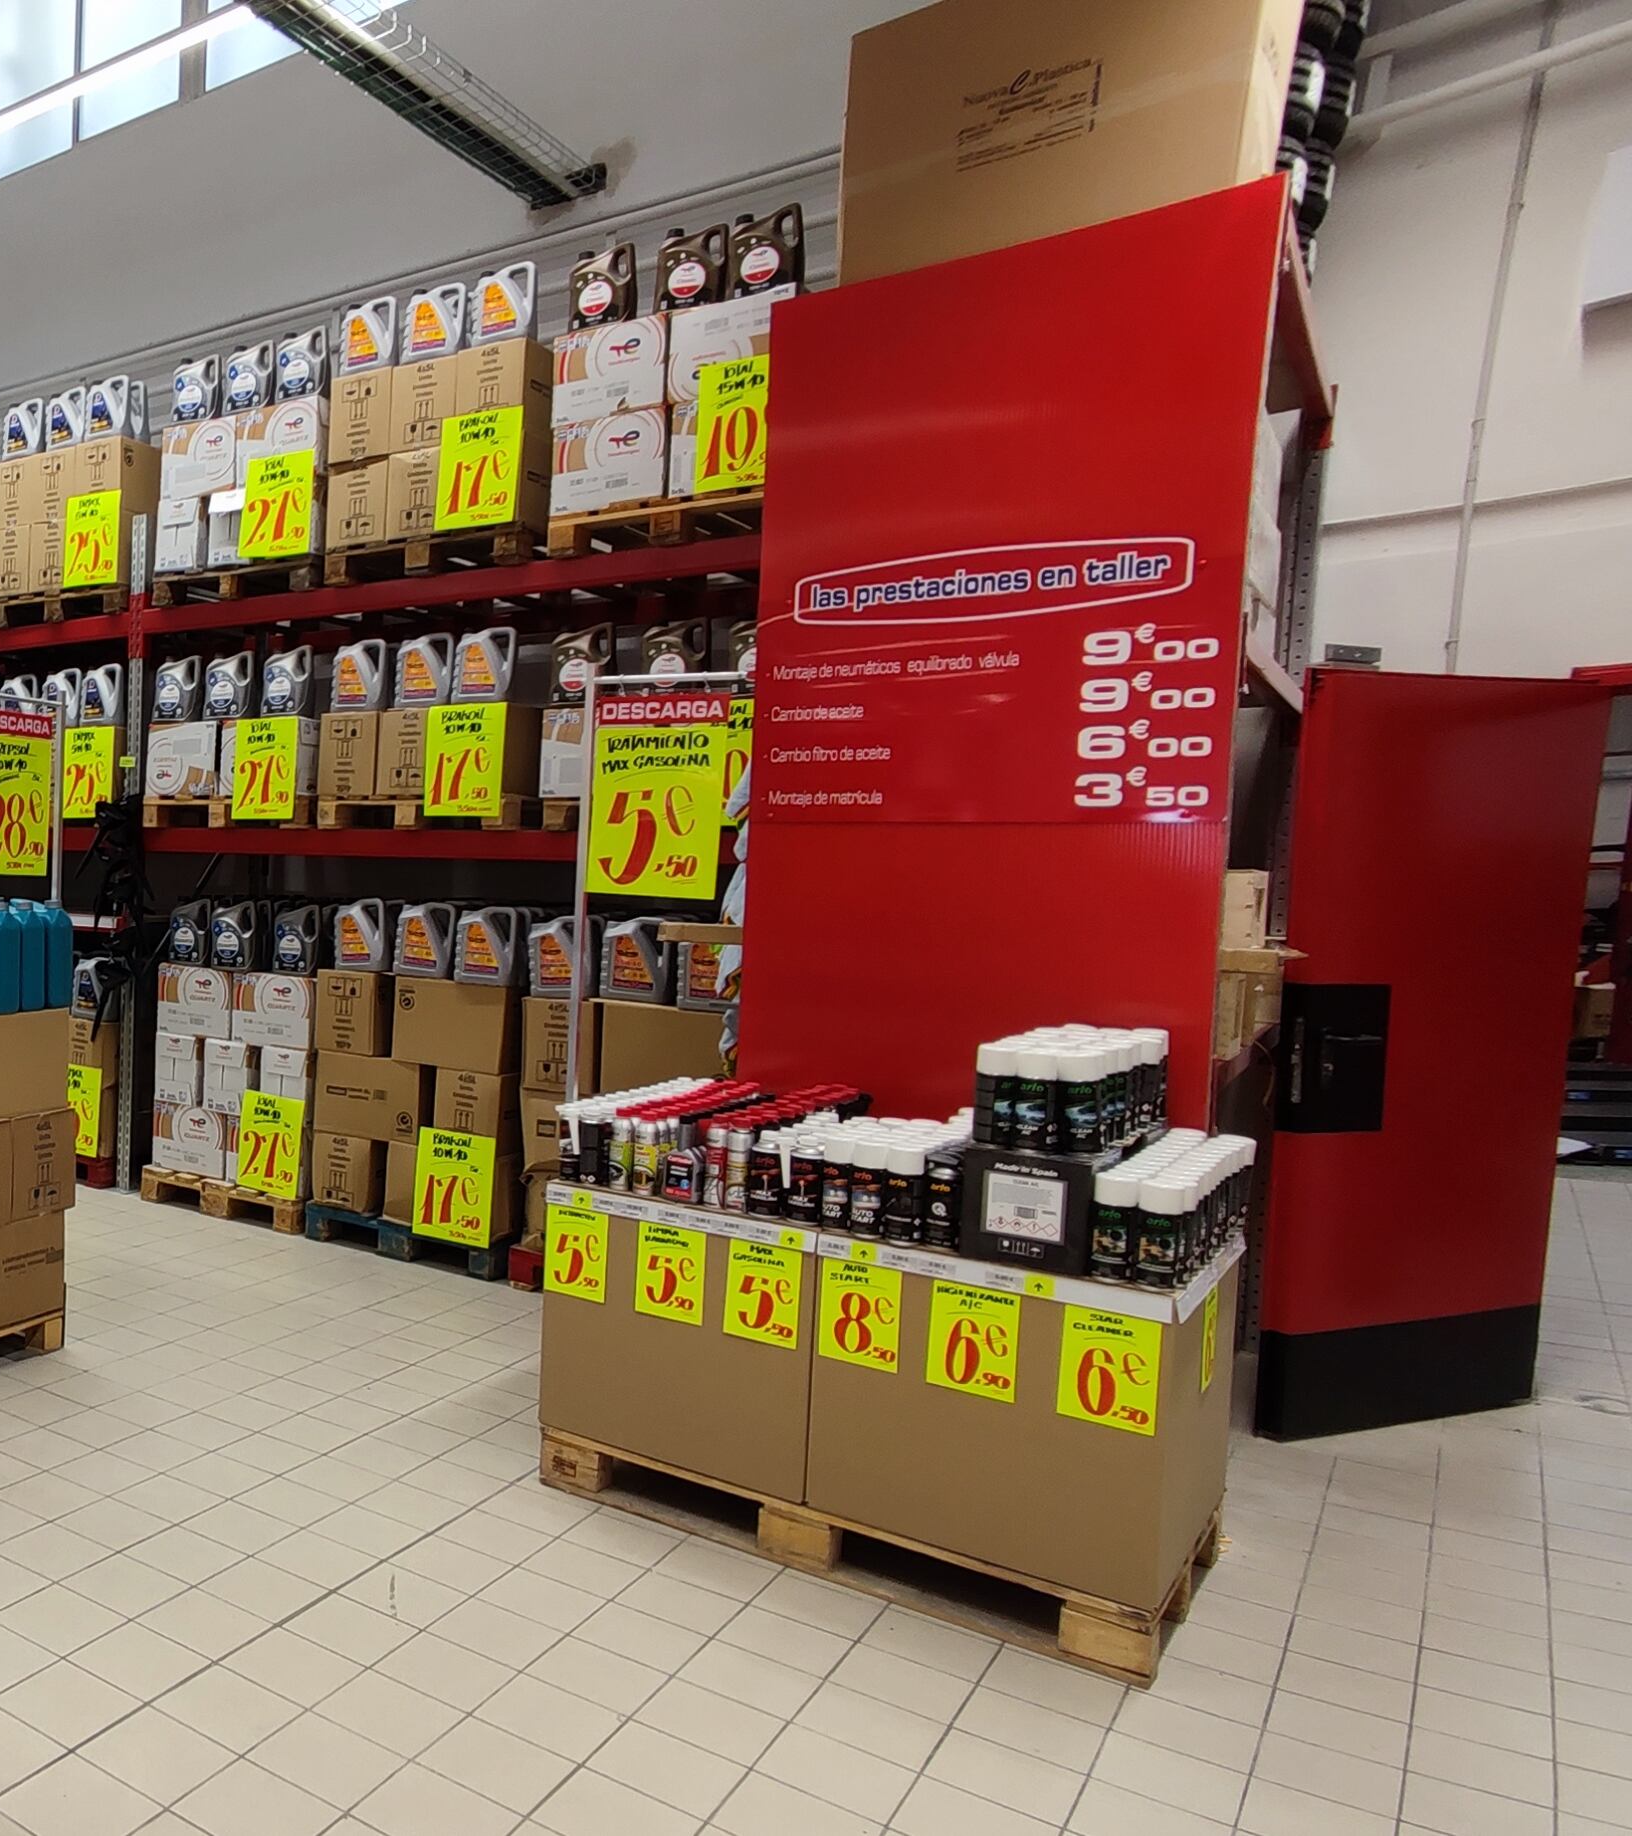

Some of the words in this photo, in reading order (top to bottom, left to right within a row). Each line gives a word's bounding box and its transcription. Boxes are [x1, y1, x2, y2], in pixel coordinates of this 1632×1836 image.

[810, 585, 847, 609] las
[852, 569, 1030, 611] prestaciones
[1040, 566, 1075, 588] en
[1085, 552, 1171, 585] taller
[773, 663, 817, 682] Montaje
[602, 700, 724, 720] DESCARGA
[770, 705, 812, 723] Cambio
[607, 733, 709, 754] TRATAMIENTO
[770, 746, 811, 763] Cambio
[601, 760, 629, 775] MAX
[768, 789, 814, 806] Montaje
[843, 1263, 869, 1274] AUTO
